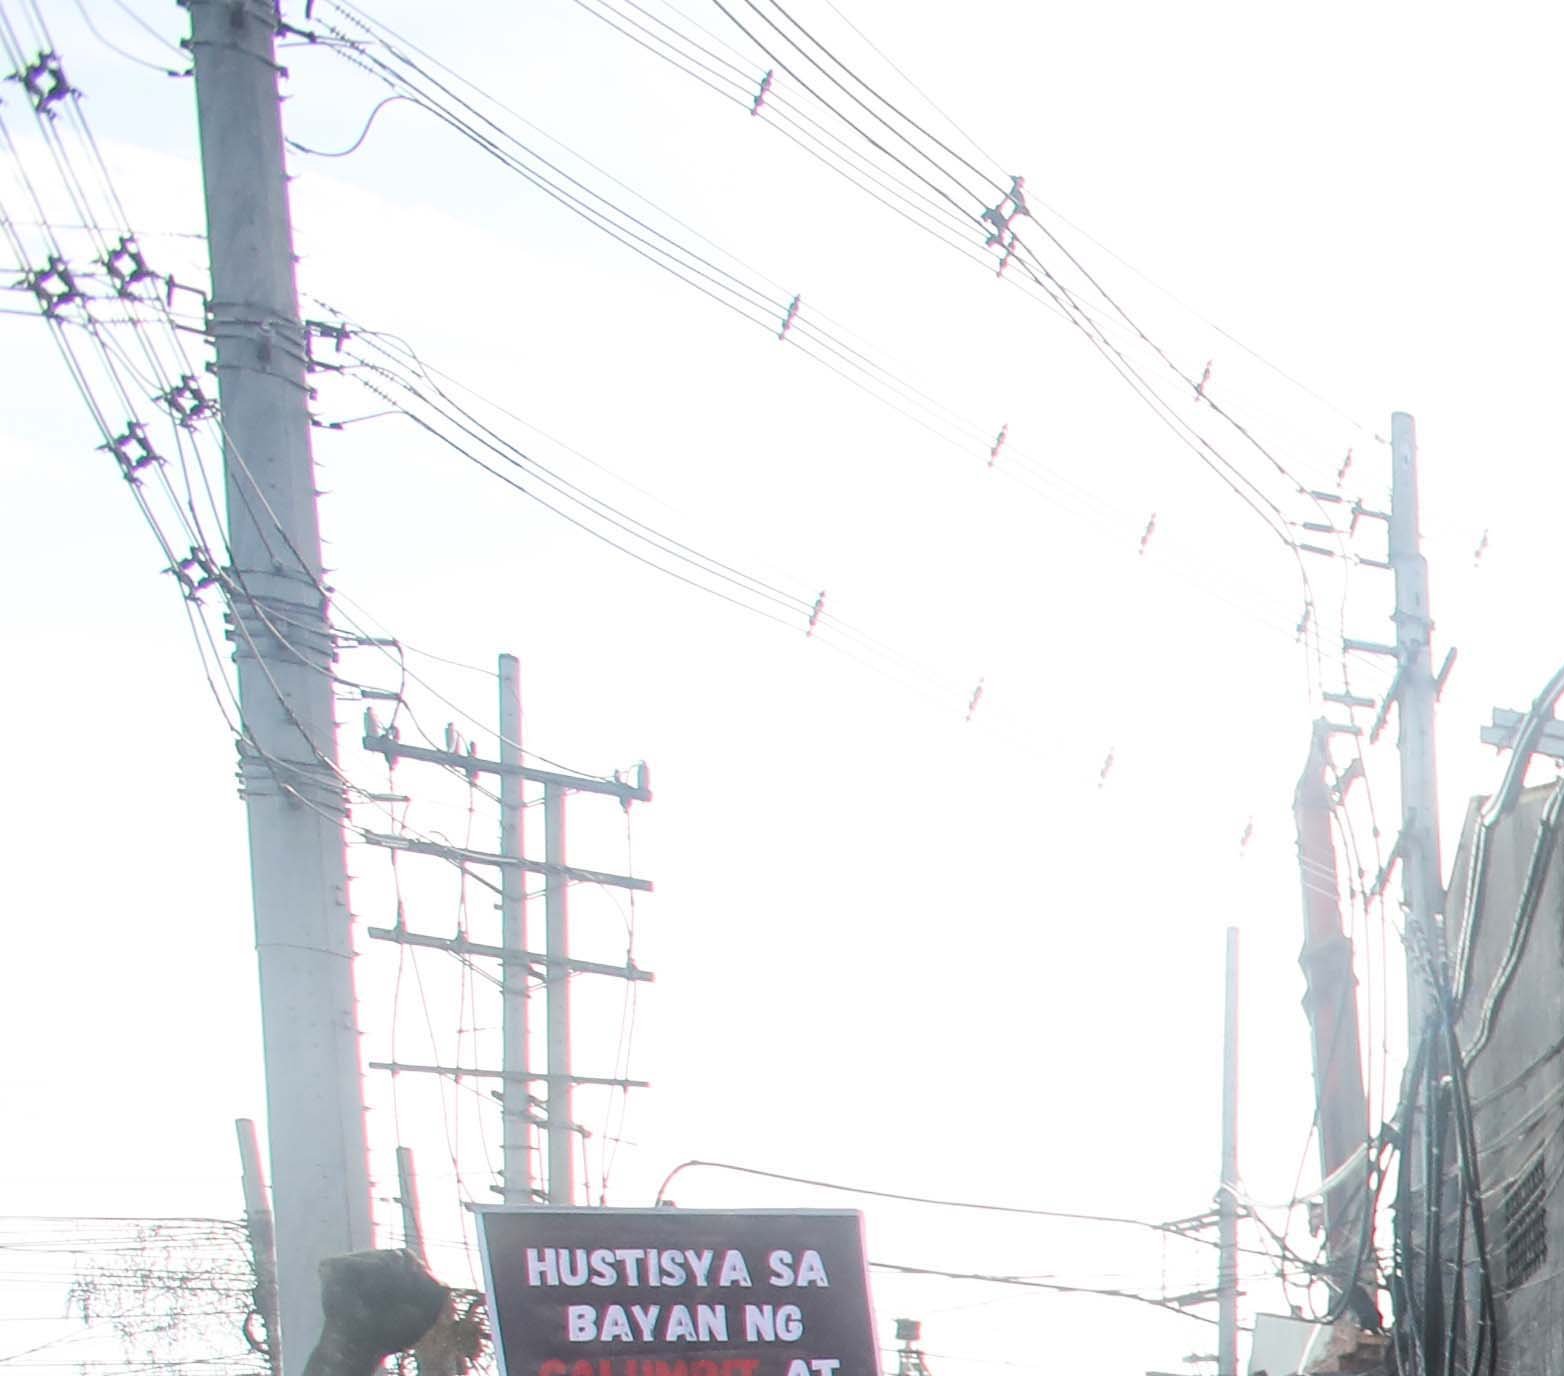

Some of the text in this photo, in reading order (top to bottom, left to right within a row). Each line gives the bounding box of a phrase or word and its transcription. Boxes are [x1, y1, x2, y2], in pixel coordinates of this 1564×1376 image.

[525, 1247, 830, 1288] HUSTISYA SA
[568, 1303, 804, 1342] BAYAN NG
